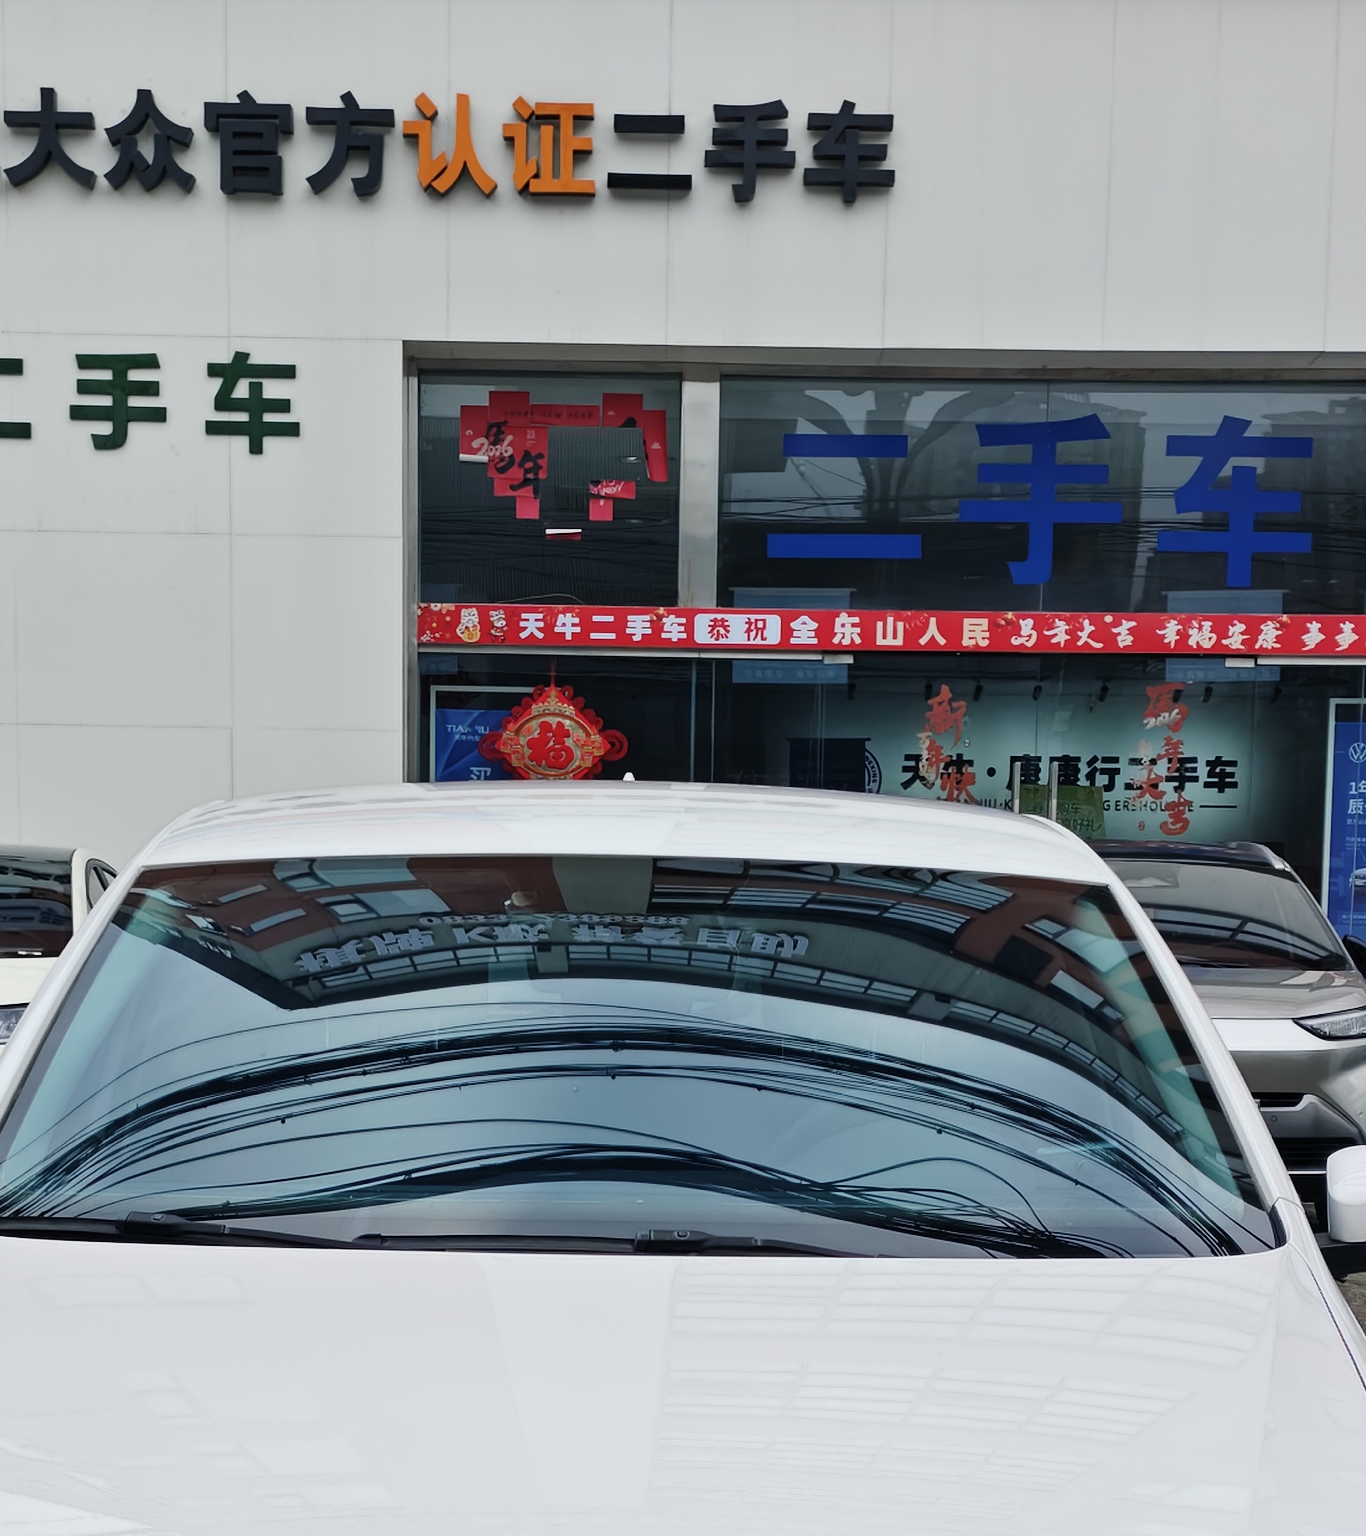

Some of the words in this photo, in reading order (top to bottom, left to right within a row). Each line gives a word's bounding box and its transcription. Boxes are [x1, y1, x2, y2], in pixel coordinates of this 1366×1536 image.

[767, 413, 1314, 589] 二手车
[519, 612, 688, 642] 天牛二手车
[707, 616, 769, 642] 恭祝
[790, 613, 991, 648] 全乐山人民
[1010, 614, 1138, 649] 马年大吉
[1155, 619, 1284, 651] 幸福安康
[527, 720, 575, 769] 福
